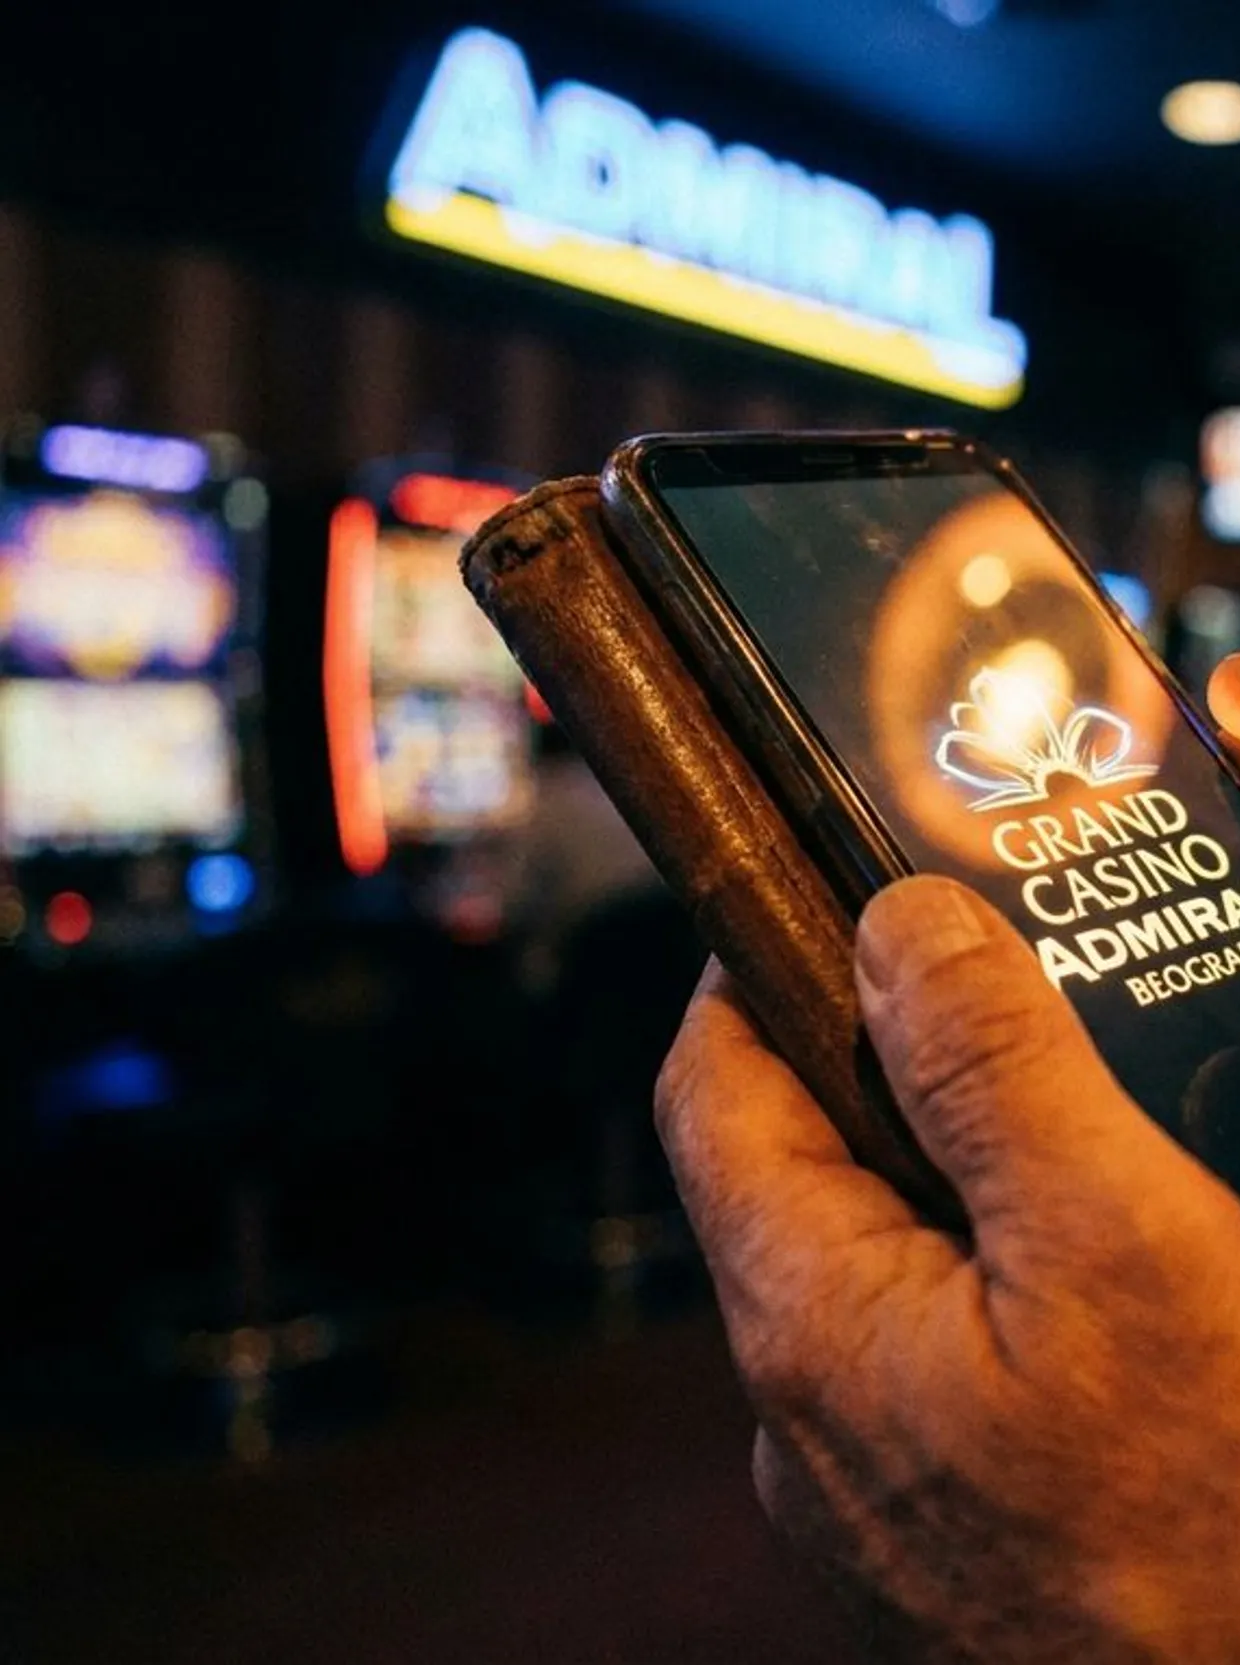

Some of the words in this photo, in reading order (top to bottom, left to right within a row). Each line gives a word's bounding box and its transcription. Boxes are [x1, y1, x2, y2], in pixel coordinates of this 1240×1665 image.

[388, 26, 1028, 387] ADMIRAL
[991, 789, 1188, 870] GRAND
[1022, 834, 1231, 925] CASINO
